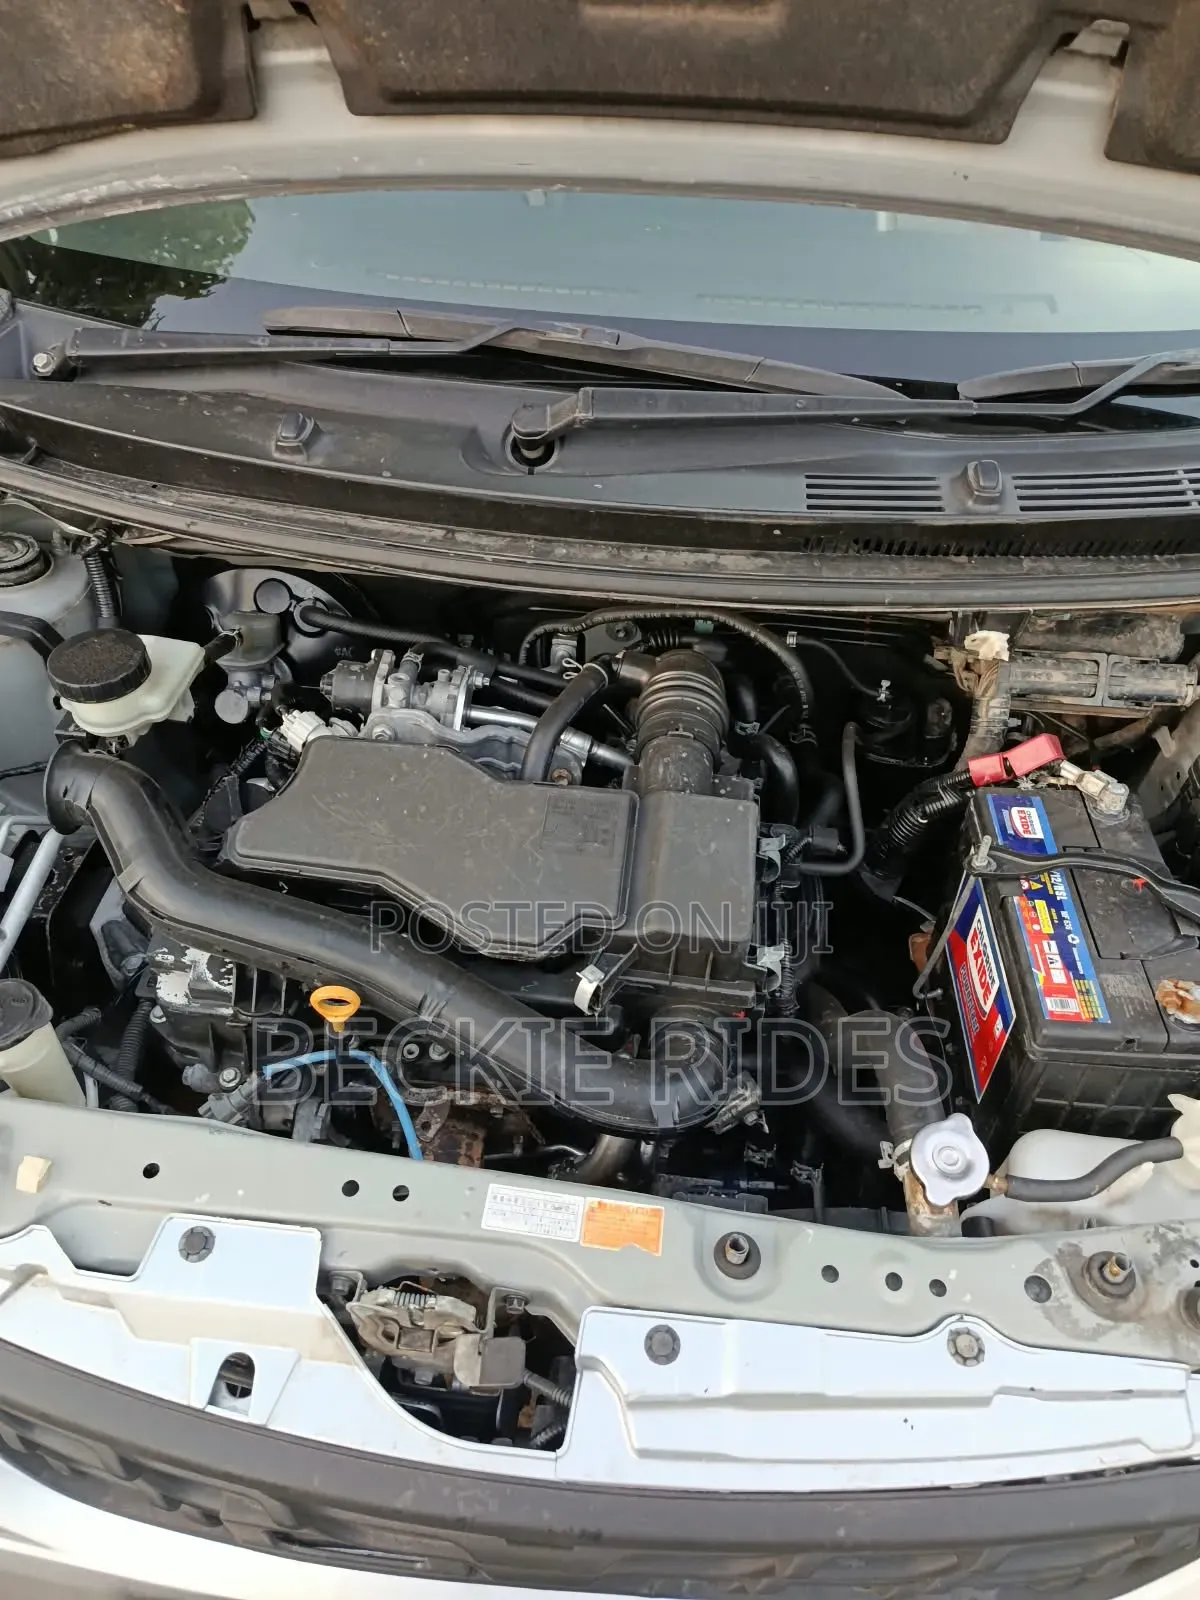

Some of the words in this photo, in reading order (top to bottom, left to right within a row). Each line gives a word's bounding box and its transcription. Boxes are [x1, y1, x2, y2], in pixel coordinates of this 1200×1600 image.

[1017, 809, 1032, 835] EXIDE
[970, 927, 992, 1006] EXIDE
[976, 918, 996, 989] CHLORIDE
